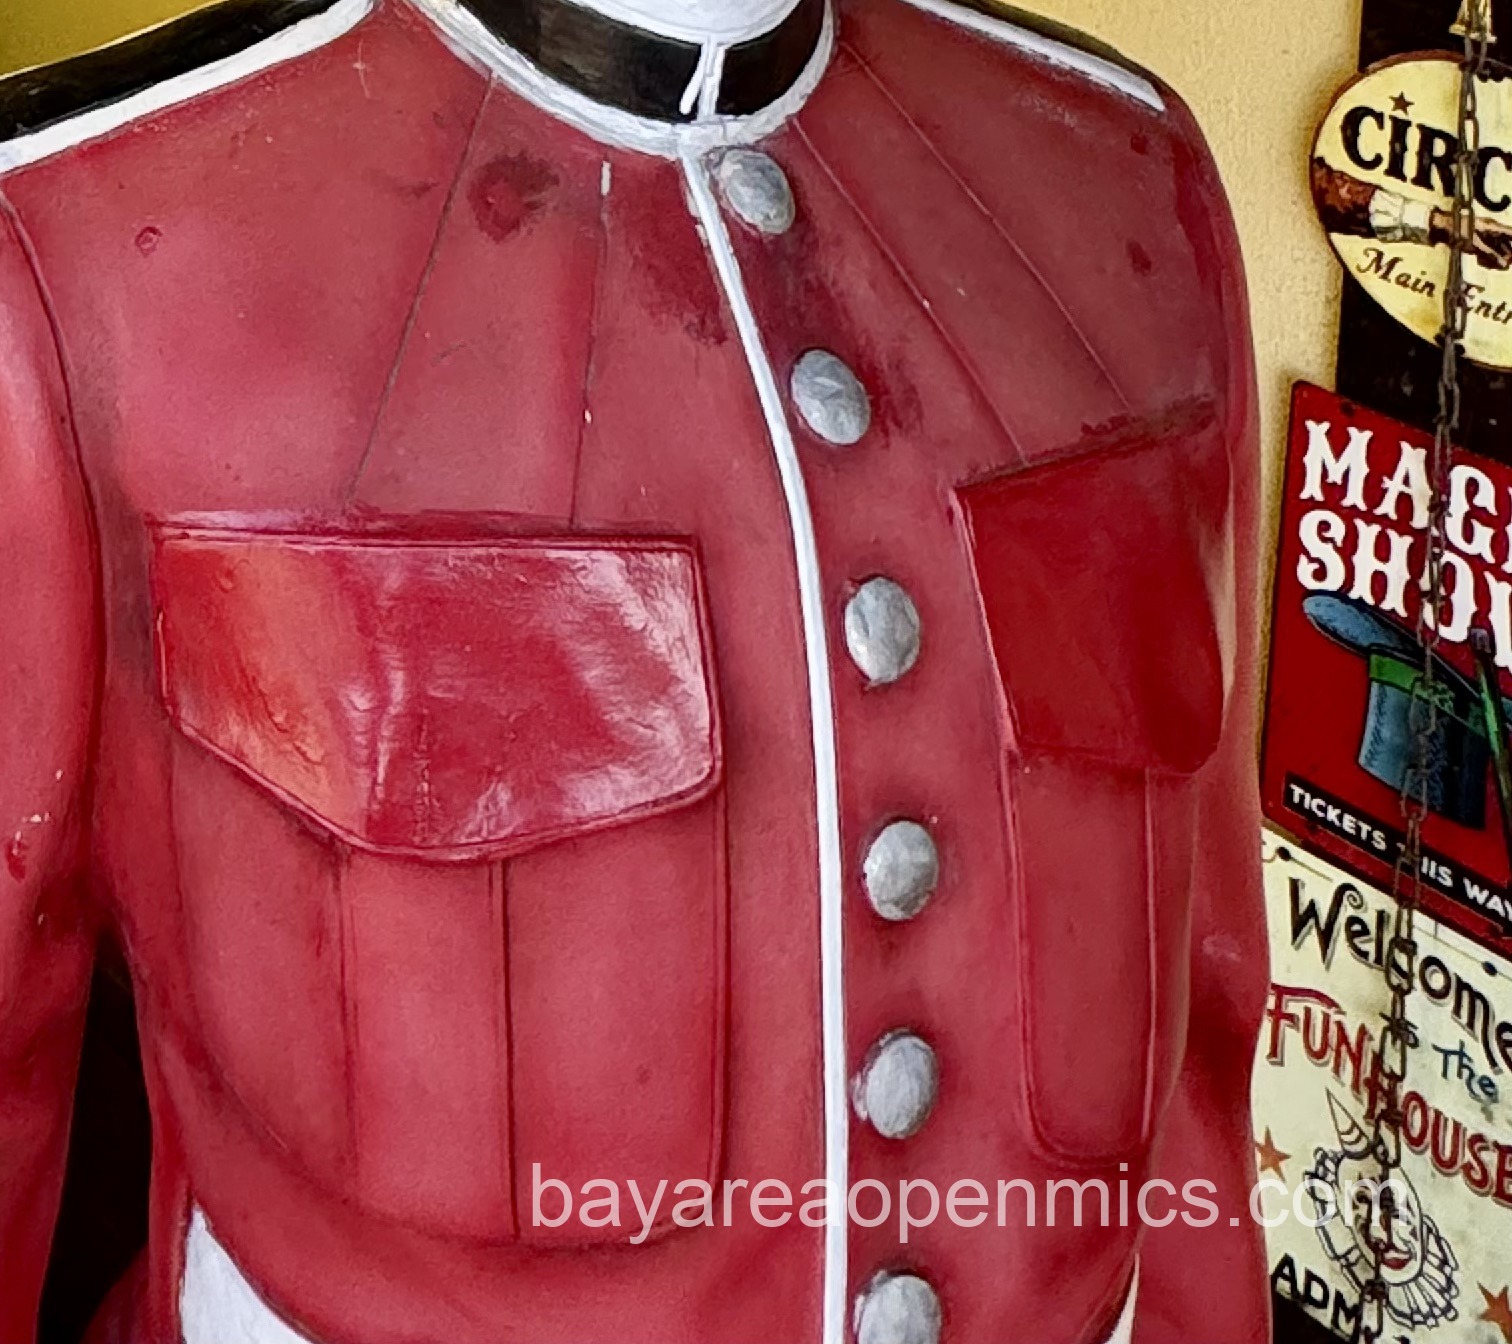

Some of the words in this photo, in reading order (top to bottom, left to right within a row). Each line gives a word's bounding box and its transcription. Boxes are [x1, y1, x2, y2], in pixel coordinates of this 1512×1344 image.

[1340, 105, 1512, 212] CIRC
[1355, 246, 1437, 299] Main
[1289, 783, 1388, 851] TICKETS
[1431, 1039, 1500, 1105] The
